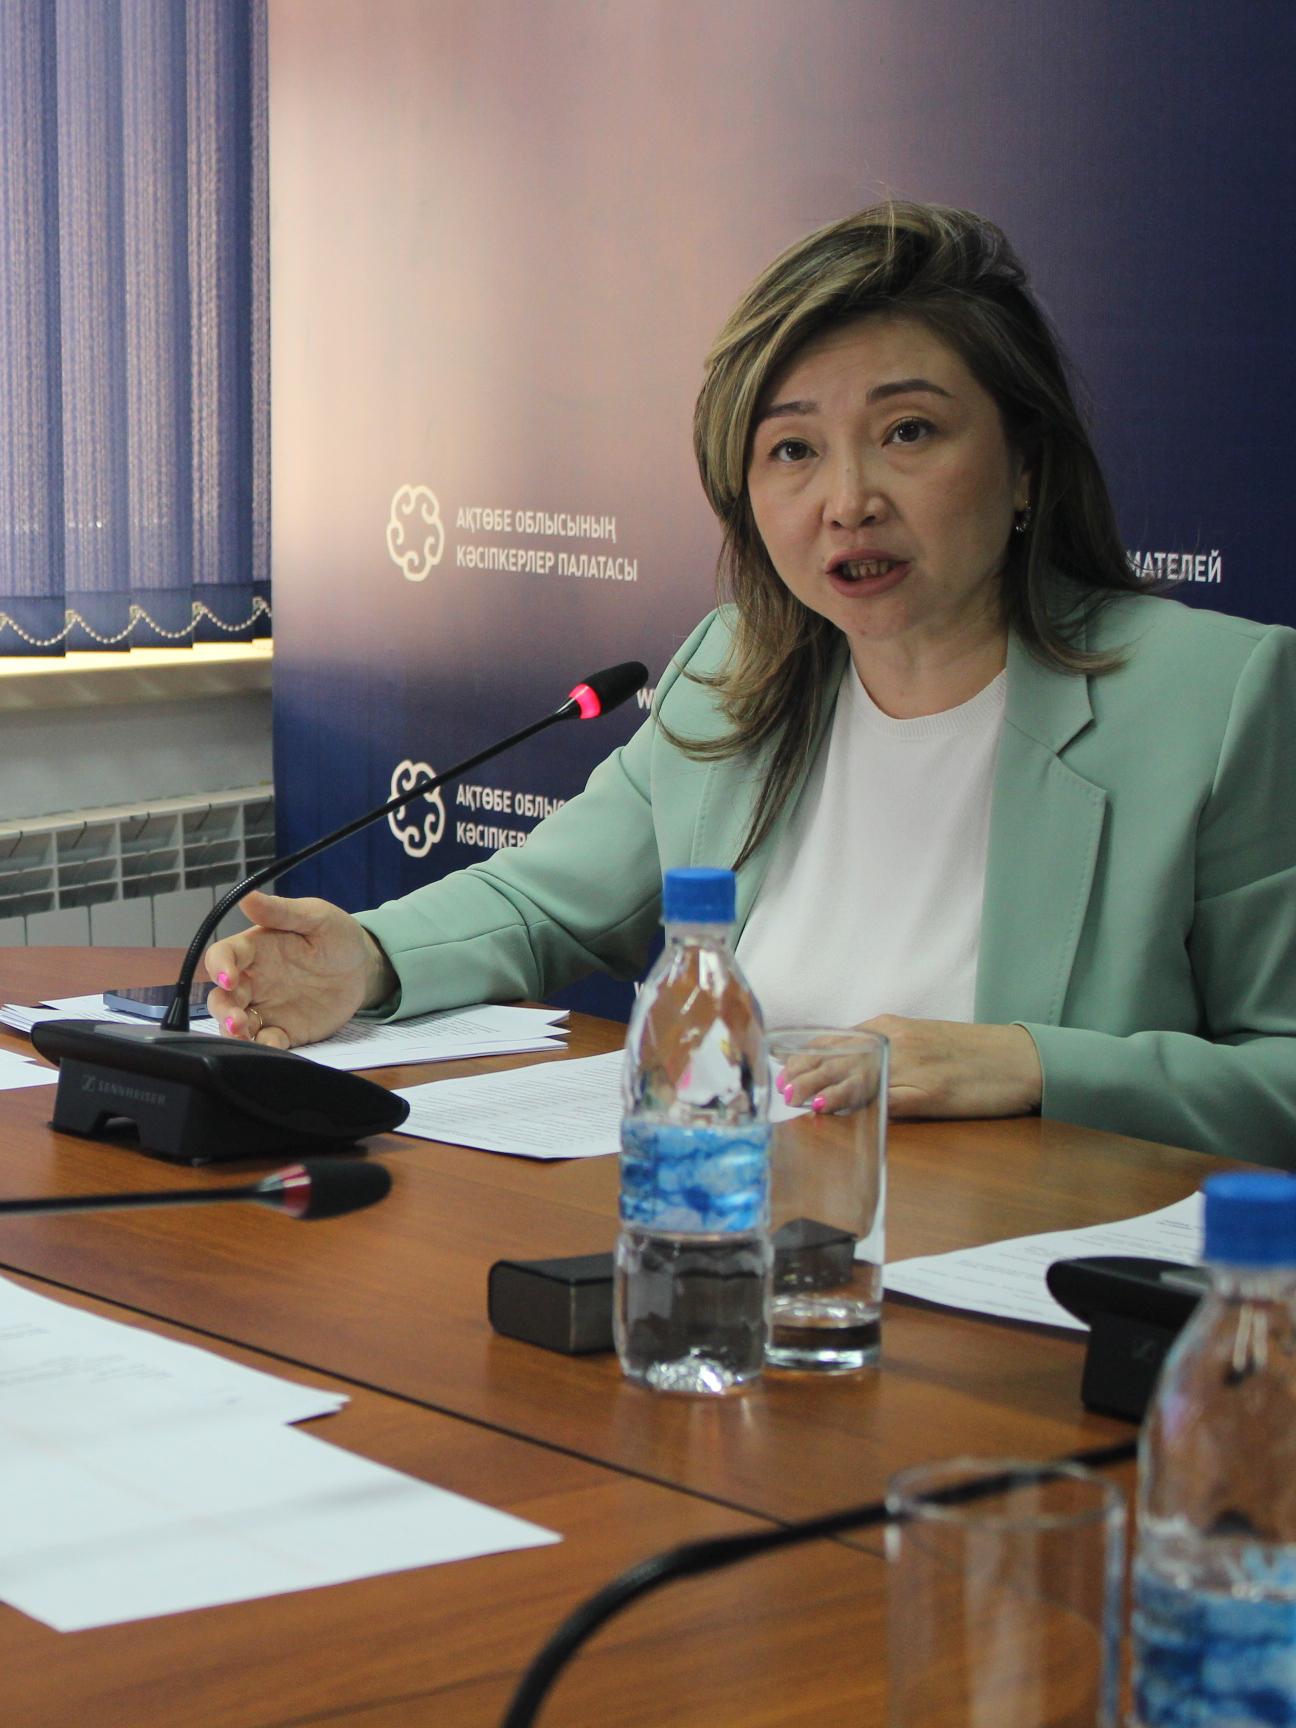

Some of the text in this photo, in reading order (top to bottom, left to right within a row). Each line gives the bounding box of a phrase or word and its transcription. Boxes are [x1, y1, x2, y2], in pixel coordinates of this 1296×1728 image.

[455, 506, 617, 544] АҚТӨБЕ ОБЛЫСЫНЫҢ
[456, 544, 639, 582] КӘСІПКЕРЛЕР ПАЛАТАСЫ
[455, 783, 512, 813] АҚТӨБЕ
